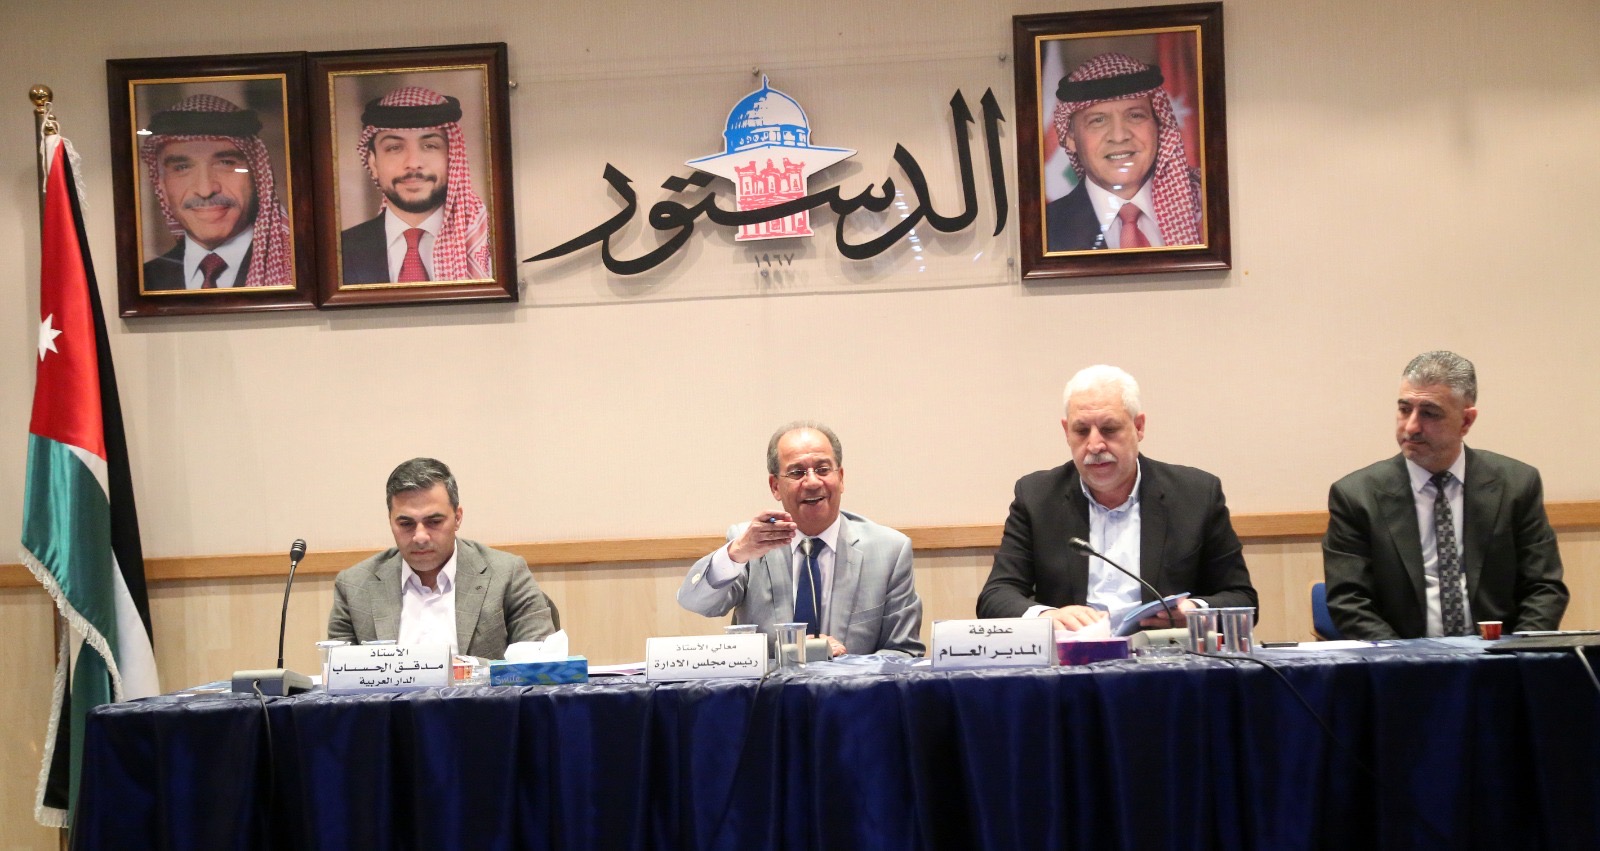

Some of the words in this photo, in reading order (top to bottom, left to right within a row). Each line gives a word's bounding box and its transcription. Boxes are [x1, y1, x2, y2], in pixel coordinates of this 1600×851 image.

[522, 85, 1008, 276] الدستور
[754, 253, 795, 268] ١٩٦٧
[969, 625, 1014, 637] عطوفة
[370, 648, 409, 658] الأستاذ
[711, 643, 737, 652] معالي
[939, 644, 987, 661] العام
[989, 644, 1041, 659] المدير
[332, 663, 391, 674] الحساب
[394, 660, 444, 673] مدقق
[692, 658, 725, 669] مجلس
[729, 658, 759, 669] رئيس
[359, 676, 392, 687] العربية
[394, 676, 416, 686] الدار
